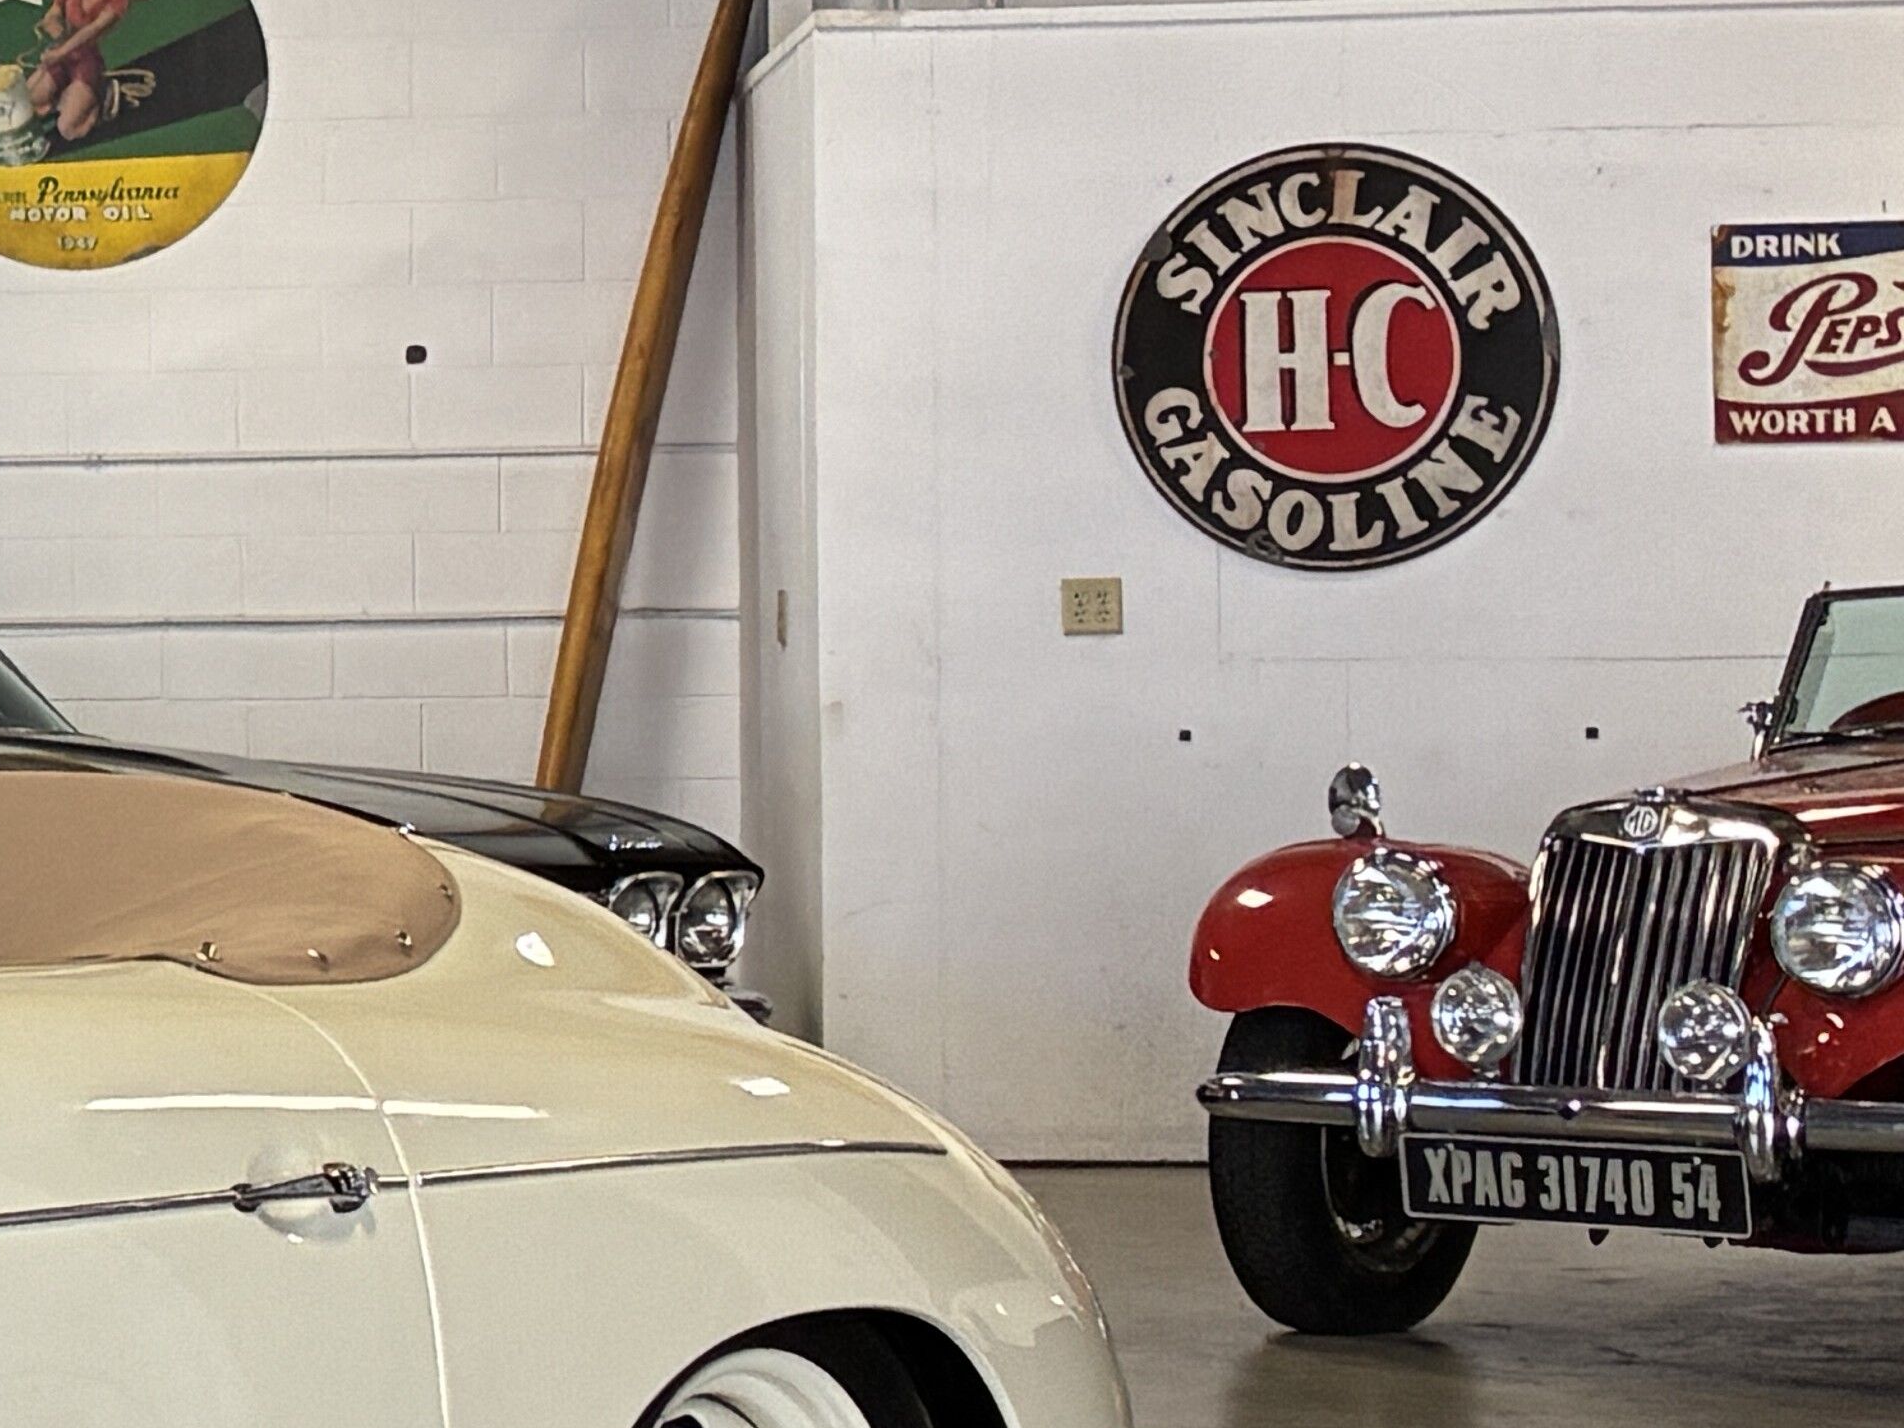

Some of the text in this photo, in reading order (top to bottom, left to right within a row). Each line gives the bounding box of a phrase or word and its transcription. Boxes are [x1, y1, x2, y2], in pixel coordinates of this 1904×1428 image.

[8, 204, 153, 223] MOTOR OIL
[36, 175, 181, 208] Pennsylvania
[1156, 169, 1521, 331] SINCLAIR
[1730, 232, 1842, 260] DRINK
[1239, 281, 1437, 434] H-C
[1729, 406, 1897, 436] WORTH A
[1143, 385, 1522, 553] GASOLINE
[1422, 1146, 1722, 1223] XPAG 31740 54
